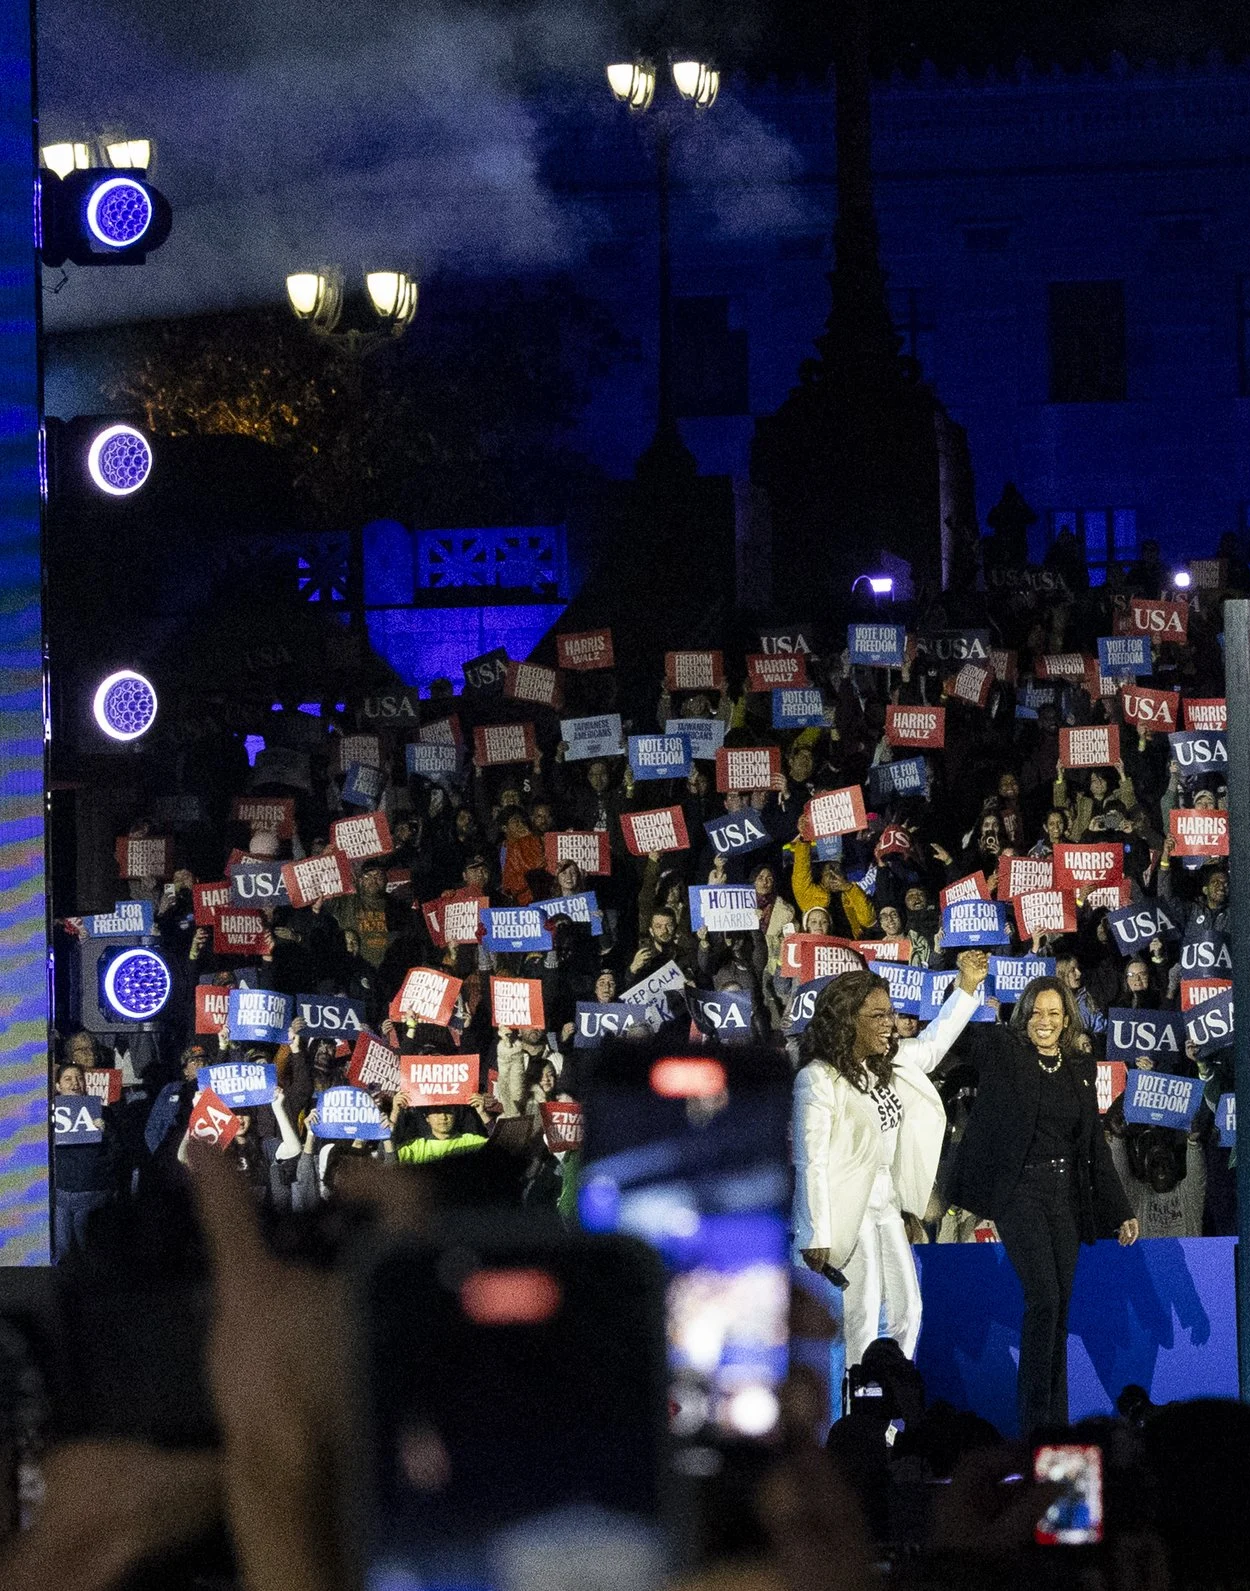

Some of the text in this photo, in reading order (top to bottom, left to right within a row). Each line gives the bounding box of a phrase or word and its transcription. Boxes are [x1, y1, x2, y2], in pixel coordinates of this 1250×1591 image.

[1134, 608, 1184, 633] USA
[855, 628, 896, 641] VOTE FOR
[565, 636, 605, 656] HARRIS
[761, 636, 811, 655] USA
[855, 640, 897, 653] FREEDOM
[572, 651, 601, 664] WALZ
[467, 659, 508, 688] USA
[755, 659, 798, 674] HARRIS
[763, 673, 794, 682] WALZ
[781, 691, 821, 704] VOTE FOR
[782, 703, 823, 716] FREEDOM
[1124, 694, 1174, 723] USA
[894, 713, 936, 729] HARRIS
[899, 729, 930, 739] WALZ
[1070, 729, 1108, 741] FREEDOM
[639, 737, 682, 752] VOTE FOR
[1070, 741, 1108, 753] FREEDOM
[639, 751, 684, 766] FREEDOM
[728, 751, 770, 764] FREEDOM
[1070, 752, 1109, 765] FREEDOM
[1174, 739, 1228, 766] USA
[728, 763, 770, 776] FREEDOM
[729, 776, 770, 788] FREEDOM
[1177, 817, 1227, 835] HARRIS
[710, 818, 765, 854] USA
[1184, 835, 1219, 846] WALZ
[1064, 852, 1114, 869] HARRIS
[1072, 869, 1106, 881] WALZ
[708, 890, 758, 910] HOTTIES
[491, 910, 541, 924] VOTE FOR
[950, 904, 997, 919] VOTE FOR
[221, 916, 263, 933] HARRIS
[492, 924, 541, 938] FREEDOM
[950, 917, 998, 932] FREEDOM
[1113, 907, 1175, 943] USA
[227, 933, 256, 944] WALZ
[1181, 941, 1232, 969] USA
[626, 968, 680, 1005] EEP CALM
[239, 994, 285, 1011] VOTE FOR
[237, 1009, 284, 1027] FREEDOM
[303, 1004, 362, 1030] USA
[1112, 1021, 1179, 1052] USA
[209, 1065, 264, 1081] VOTE FOR
[411, 1064, 469, 1083] HARRIS
[211, 1076, 266, 1094] FREEDOM
[419, 1083, 460, 1095] WALZ
[1137, 1074, 1192, 1097] VOTE FOR
[1133, 1091, 1189, 1113] FREEDOM
